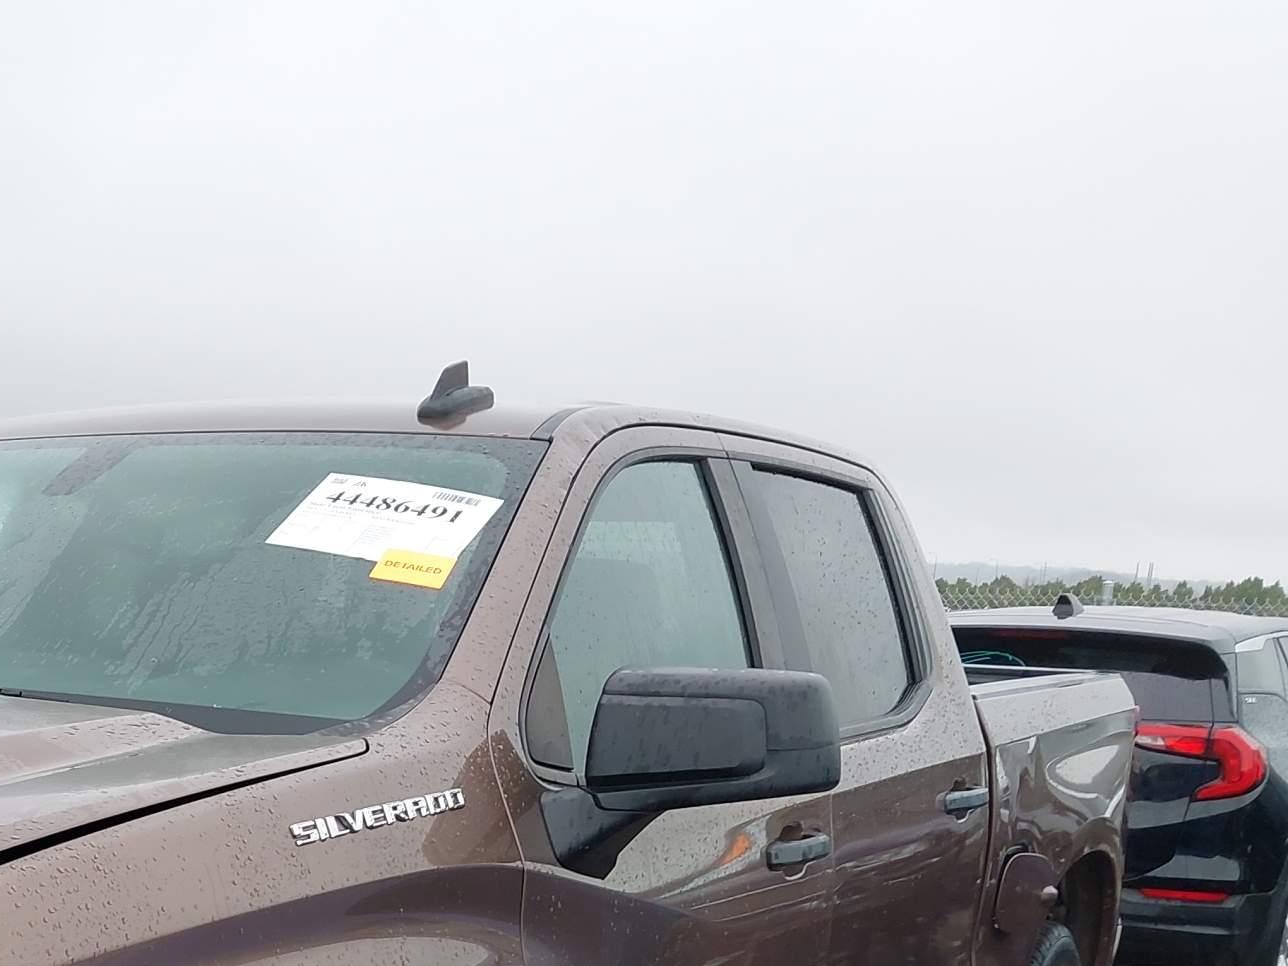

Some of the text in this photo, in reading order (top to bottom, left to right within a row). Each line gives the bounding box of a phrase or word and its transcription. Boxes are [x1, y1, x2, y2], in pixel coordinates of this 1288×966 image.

[325, 489, 464, 524] 44486491
[384, 558, 443, 576] DETAILED
[289, 787, 466, 847] SILVERADO
